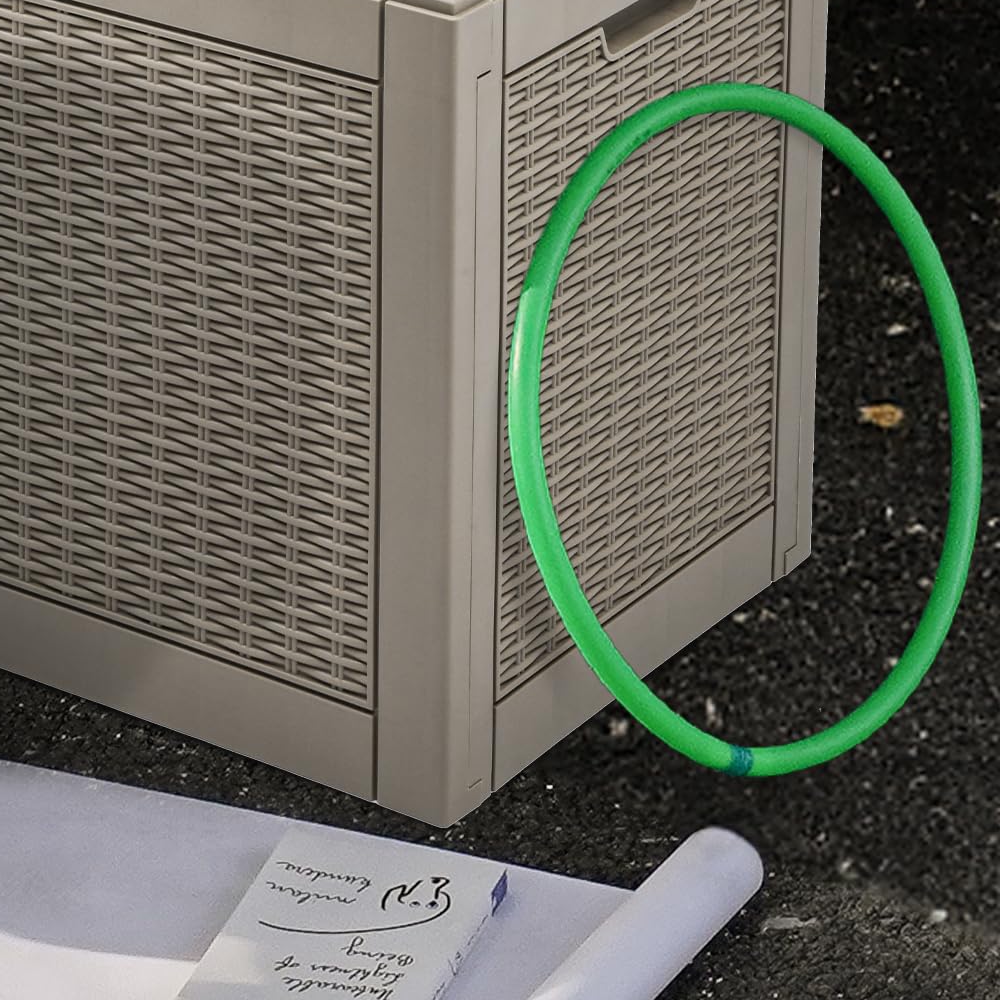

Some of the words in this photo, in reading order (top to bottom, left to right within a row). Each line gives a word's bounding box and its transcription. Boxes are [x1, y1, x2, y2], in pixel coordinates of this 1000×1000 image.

[266, 881, 357, 904] milan
[341, 935, 414, 967] Being
[274, 955, 300, 972] of
